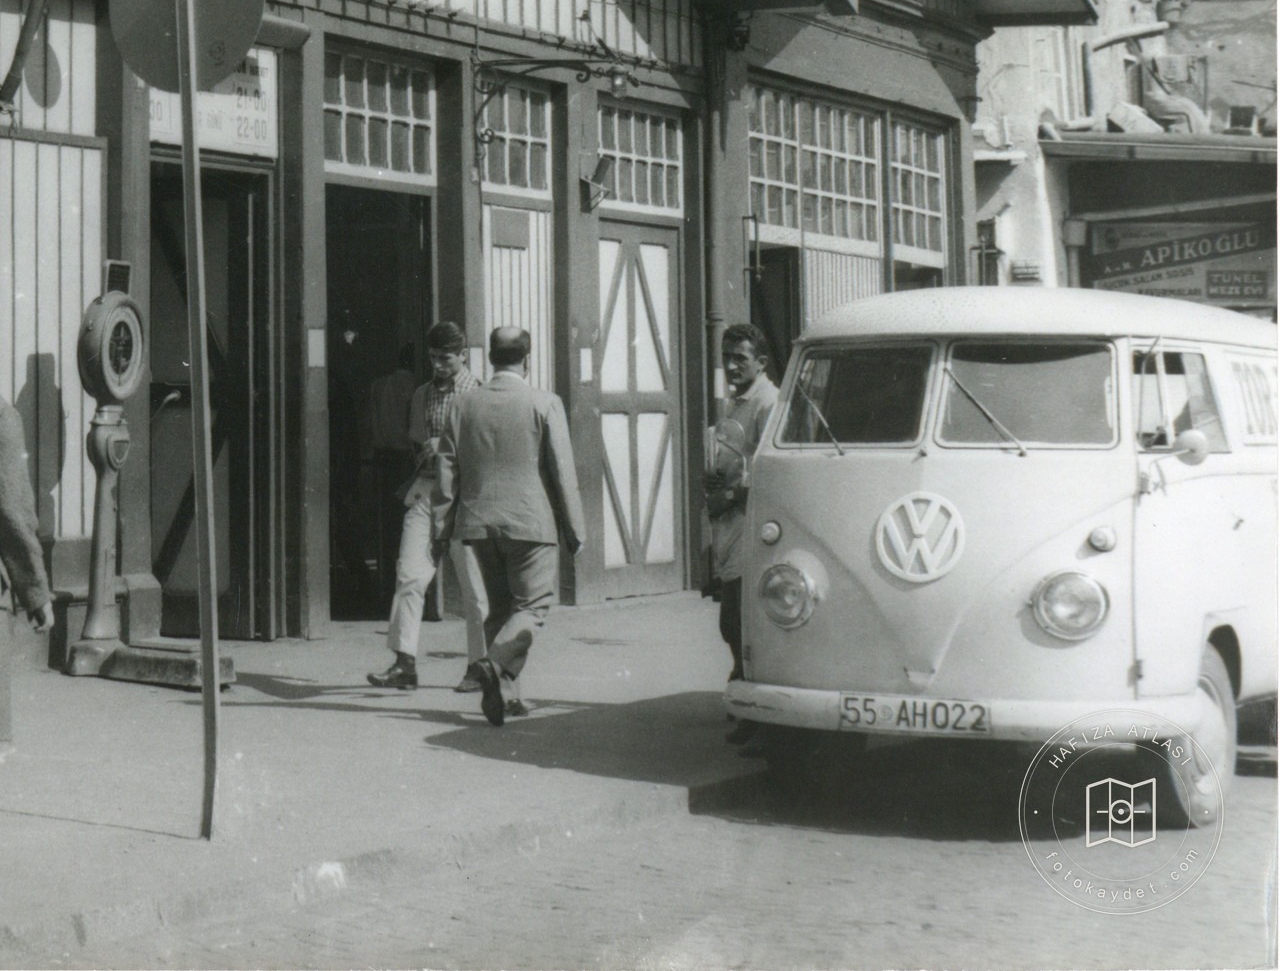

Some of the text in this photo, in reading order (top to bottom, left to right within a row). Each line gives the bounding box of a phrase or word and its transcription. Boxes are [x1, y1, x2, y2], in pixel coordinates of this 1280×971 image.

[236, 86, 267, 112] 21-00
[236, 116, 268, 141] 22-00
[843, 697, 877, 726] 55
